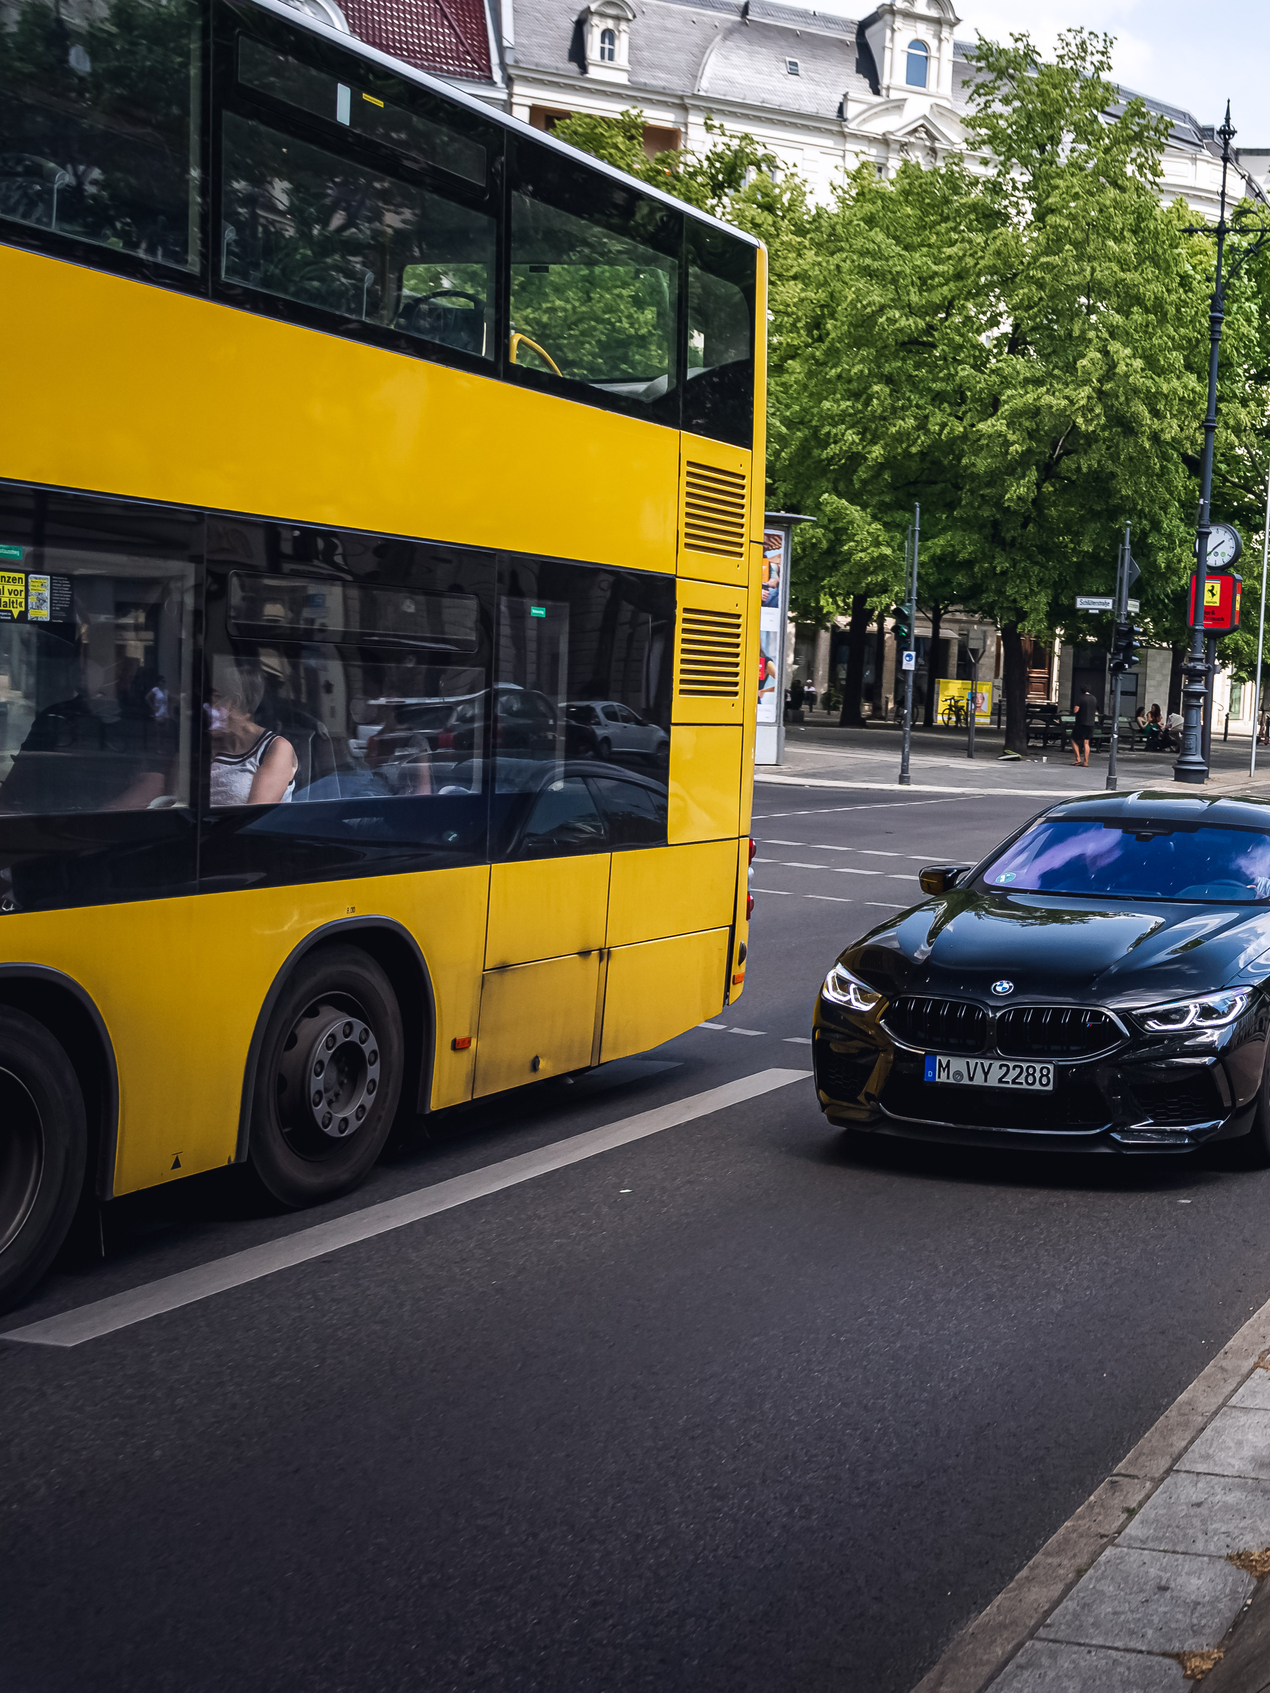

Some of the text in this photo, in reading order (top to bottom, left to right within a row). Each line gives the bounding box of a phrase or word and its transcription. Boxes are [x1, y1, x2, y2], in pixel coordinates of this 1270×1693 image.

[7, 588, 24, 597] vor
[0, 598, 24, 609] alt!«
[937, 1058, 951, 1080] M
[997, 1063, 1051, 1088] 2288
